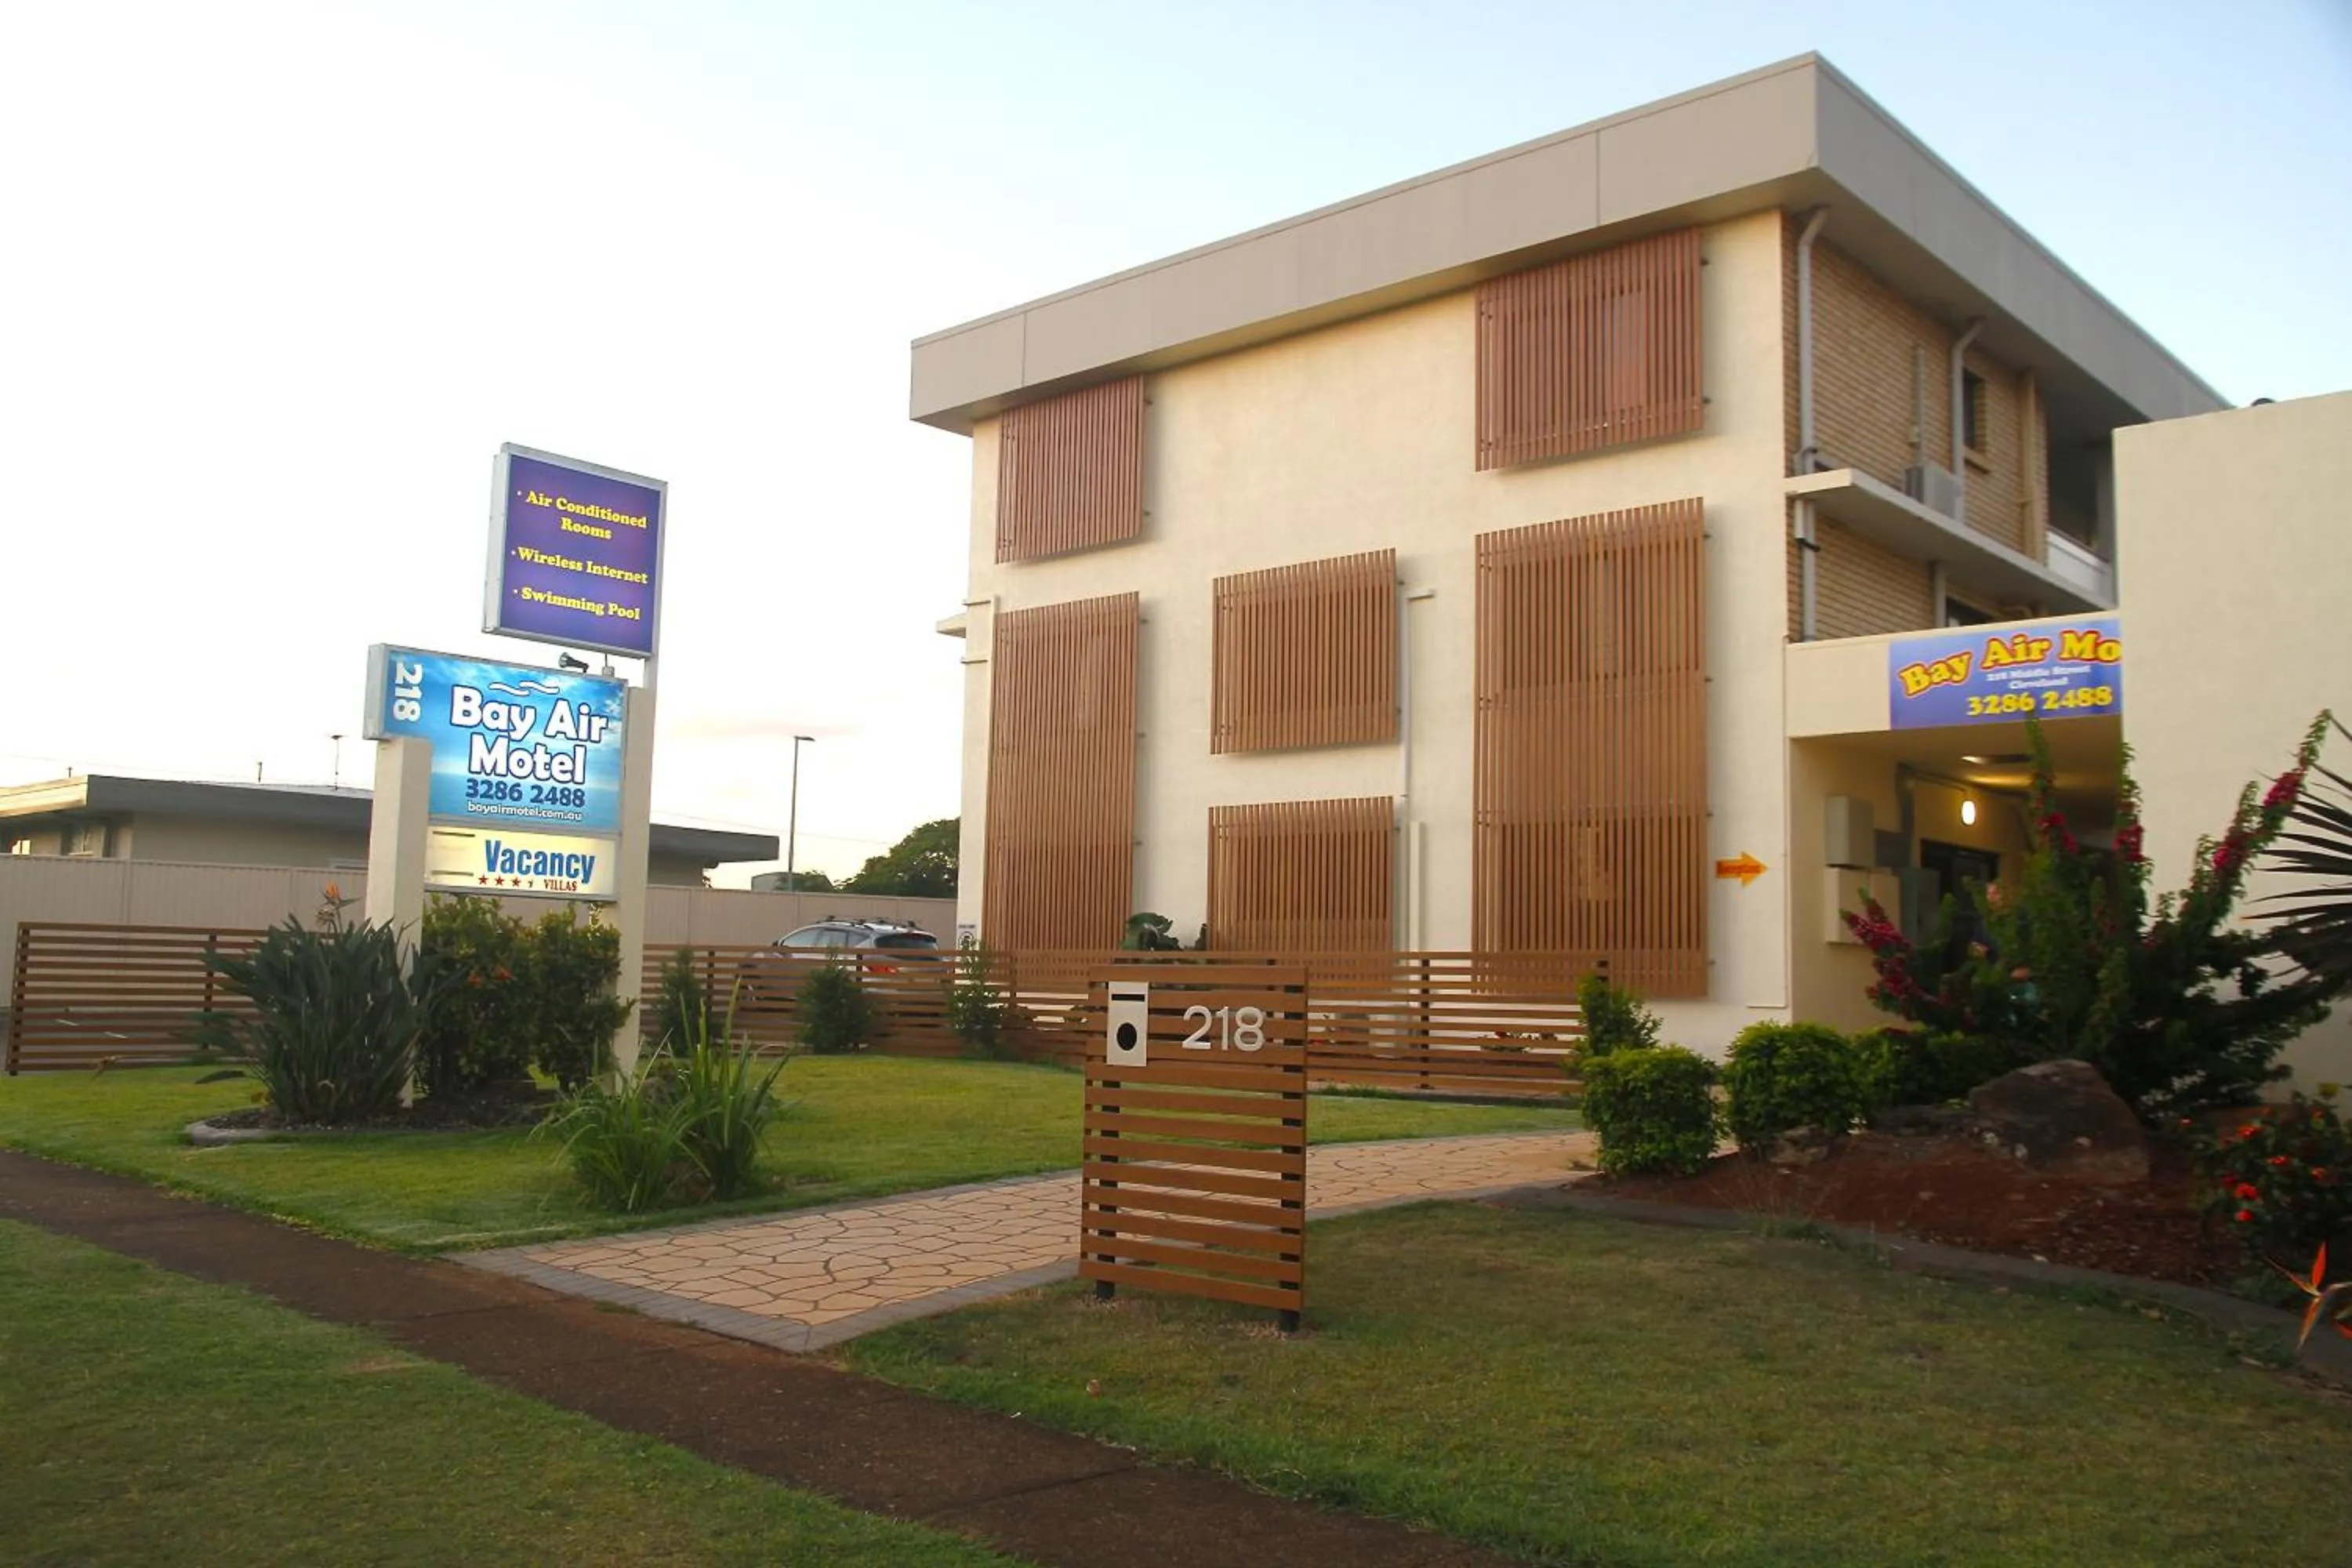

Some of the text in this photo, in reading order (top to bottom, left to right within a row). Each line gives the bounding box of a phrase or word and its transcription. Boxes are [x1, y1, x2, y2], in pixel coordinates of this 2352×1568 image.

[525, 491, 647, 528] Air Conditioned
[560, 517, 612, 539] Rooms
[517, 546, 648, 584] Wireless Internet
[521, 587, 640, 620] Swimming Pool
[1898, 652, 1973, 697] Bay
[1981, 634, 2052, 669] Air
[393, 663, 423, 722] 218
[1967, 687, 2112, 716] 3286 2488
[452, 686, 609, 742] Bay Air
[469, 733, 587, 783] Motel
[466, 778, 586, 808] 3286 2488
[467, 800, 582, 821] bayairmotel.com.au
[485, 840, 595, 884] Vacancy
[544, 879, 577, 891] VILLAS
[1183, 1005, 1265, 1051] 218
